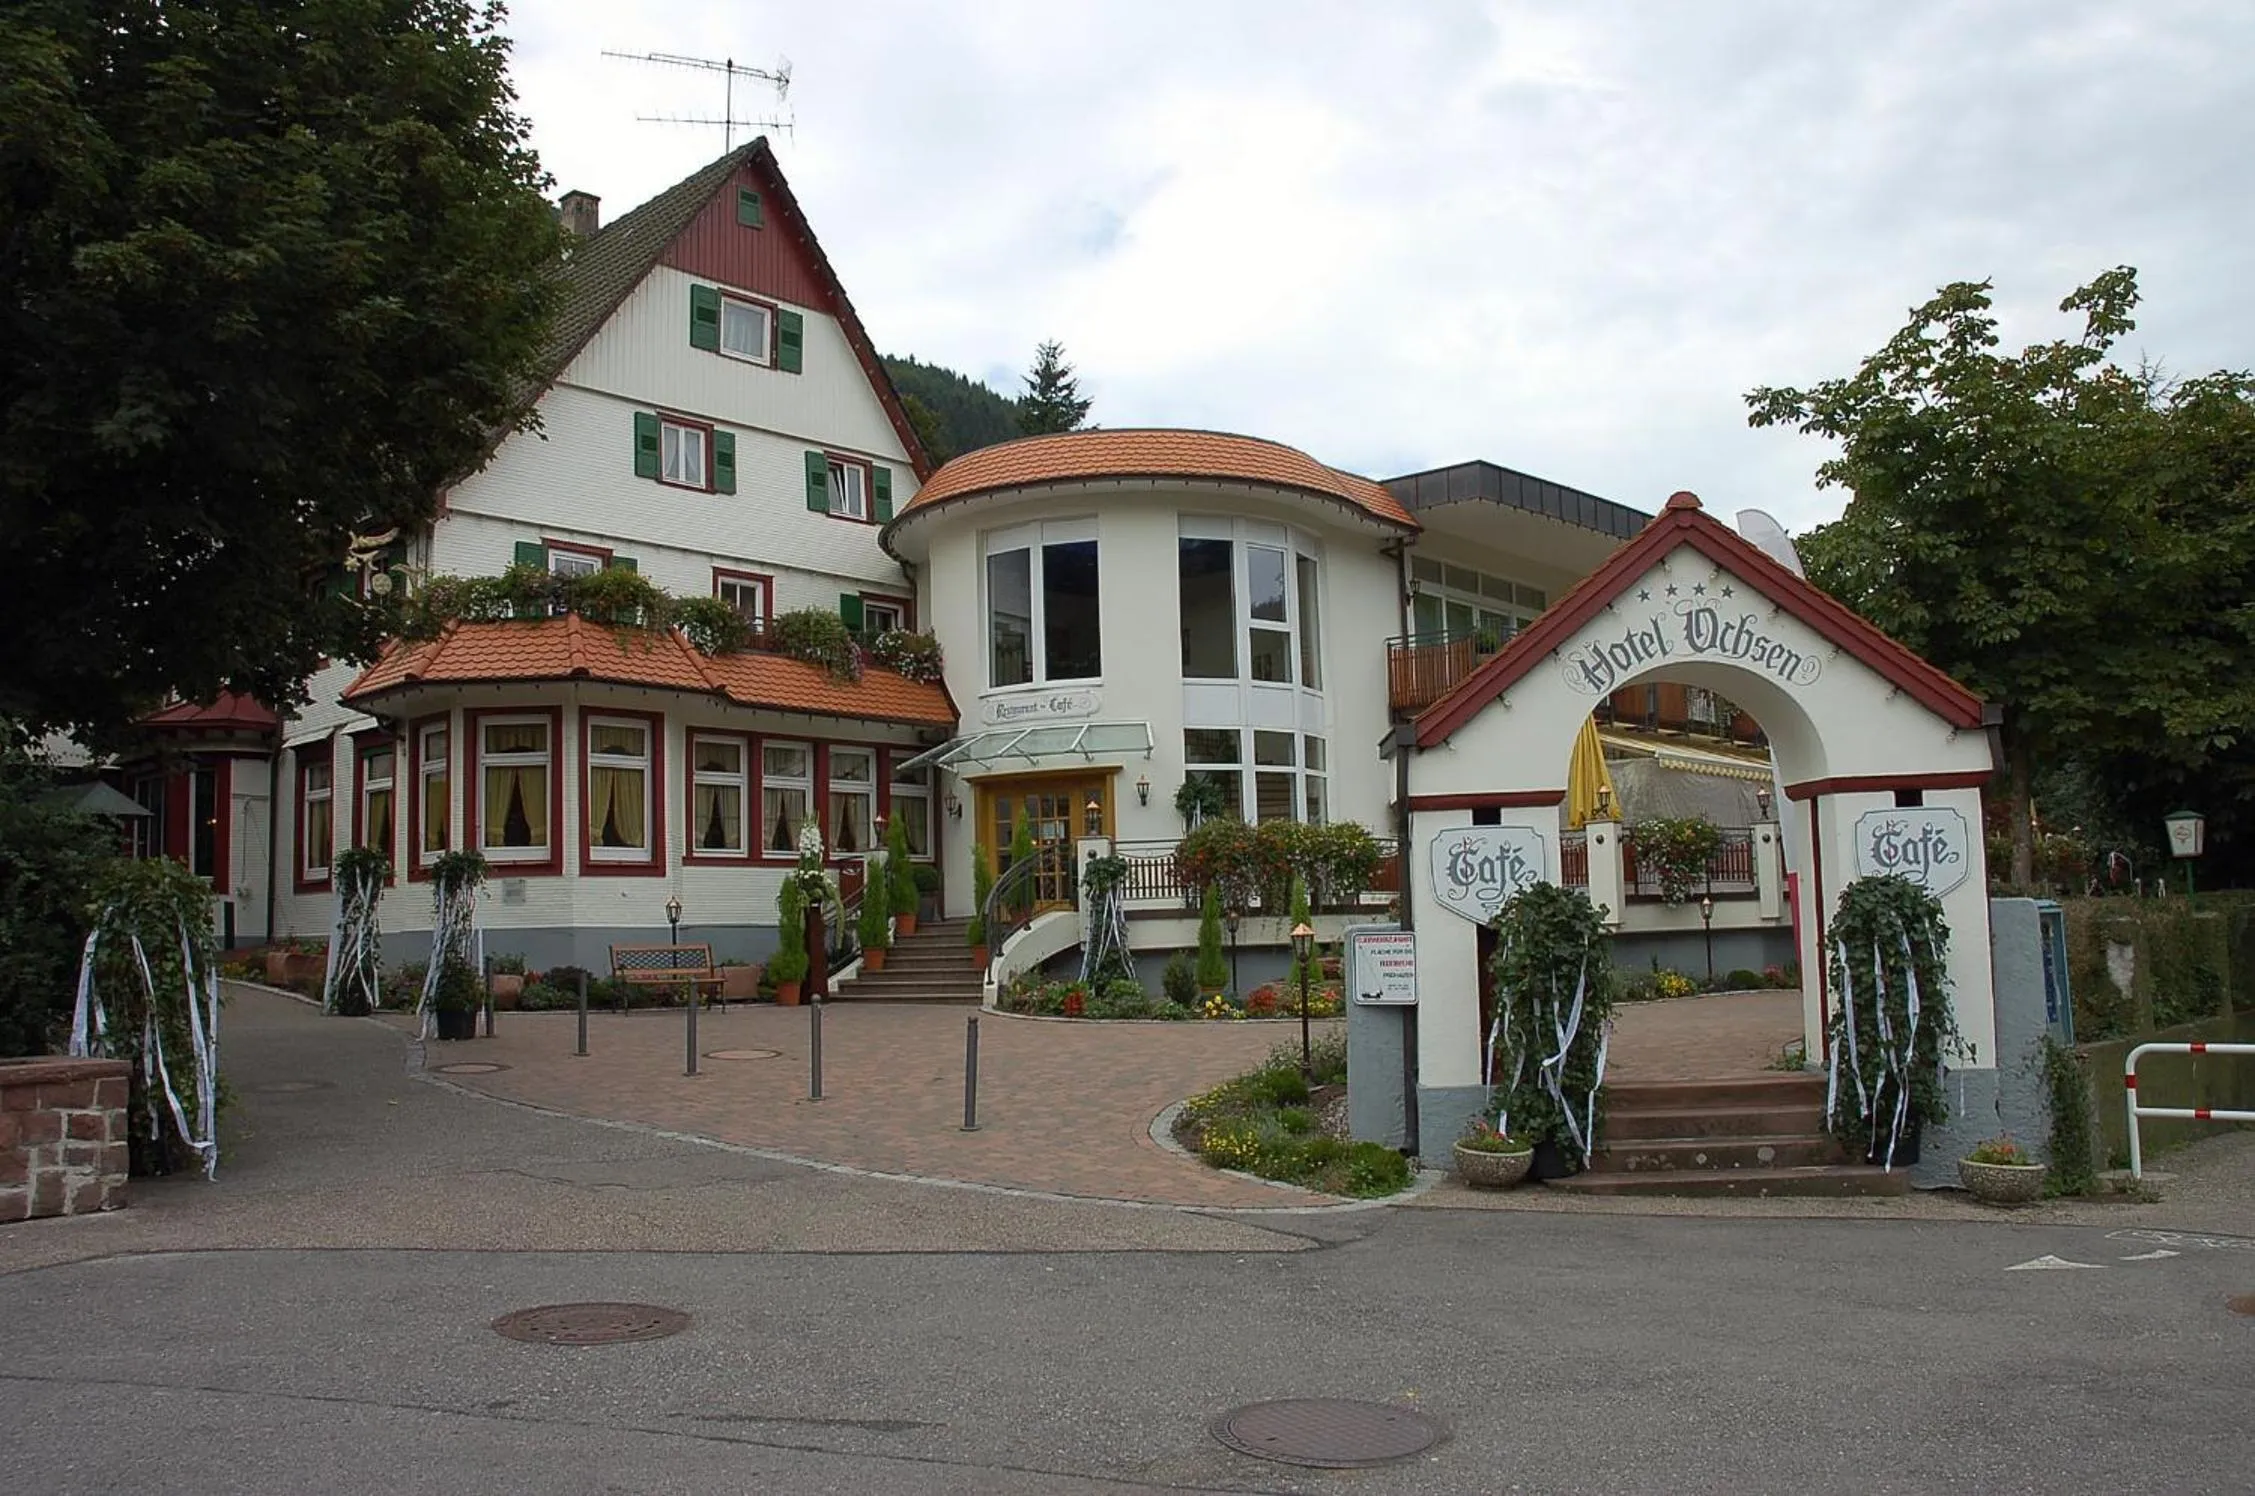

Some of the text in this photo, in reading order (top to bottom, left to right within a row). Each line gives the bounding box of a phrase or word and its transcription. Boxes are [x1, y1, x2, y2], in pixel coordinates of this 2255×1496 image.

[1566, 601, 1817, 694] Hotel Ochsen
[1049, 697, 1073, 713] Café
[1446, 836, 1538, 903] Café
[1869, 818, 1960, 884] Café
